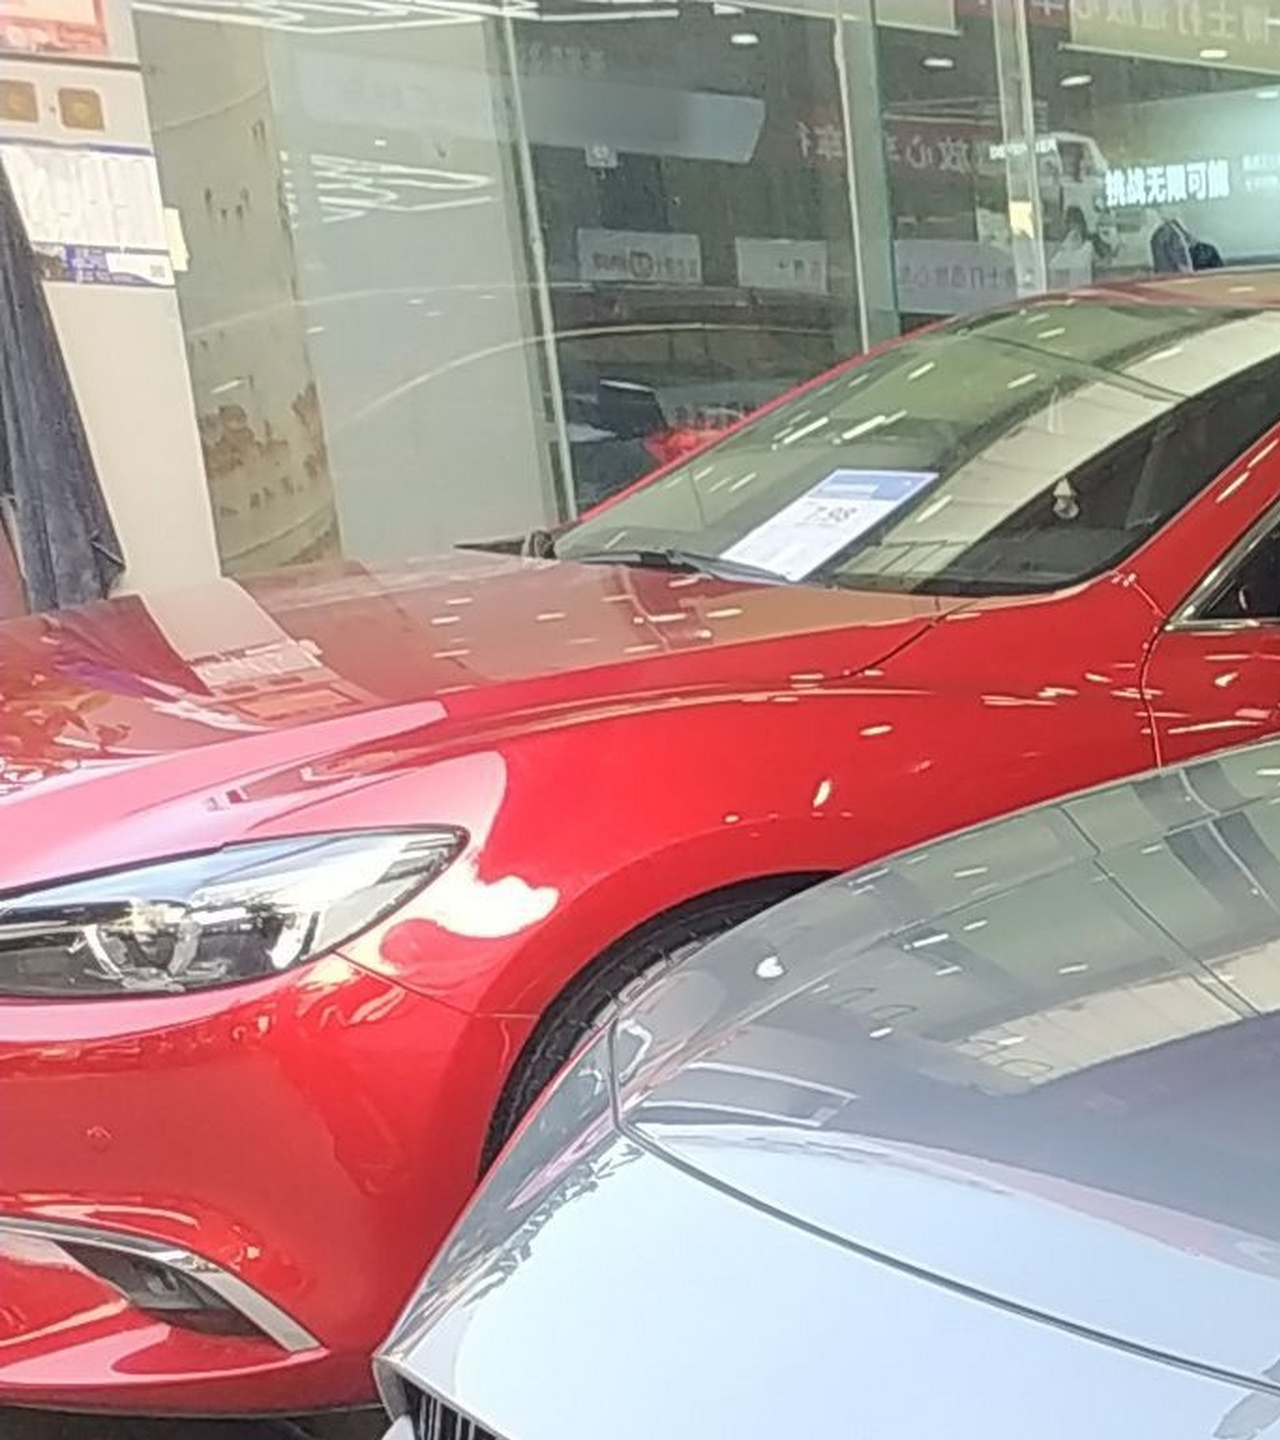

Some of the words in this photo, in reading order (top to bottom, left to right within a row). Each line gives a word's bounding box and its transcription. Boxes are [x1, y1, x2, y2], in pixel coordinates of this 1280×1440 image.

[1105, 159, 1231, 207] 挑战无限可能
